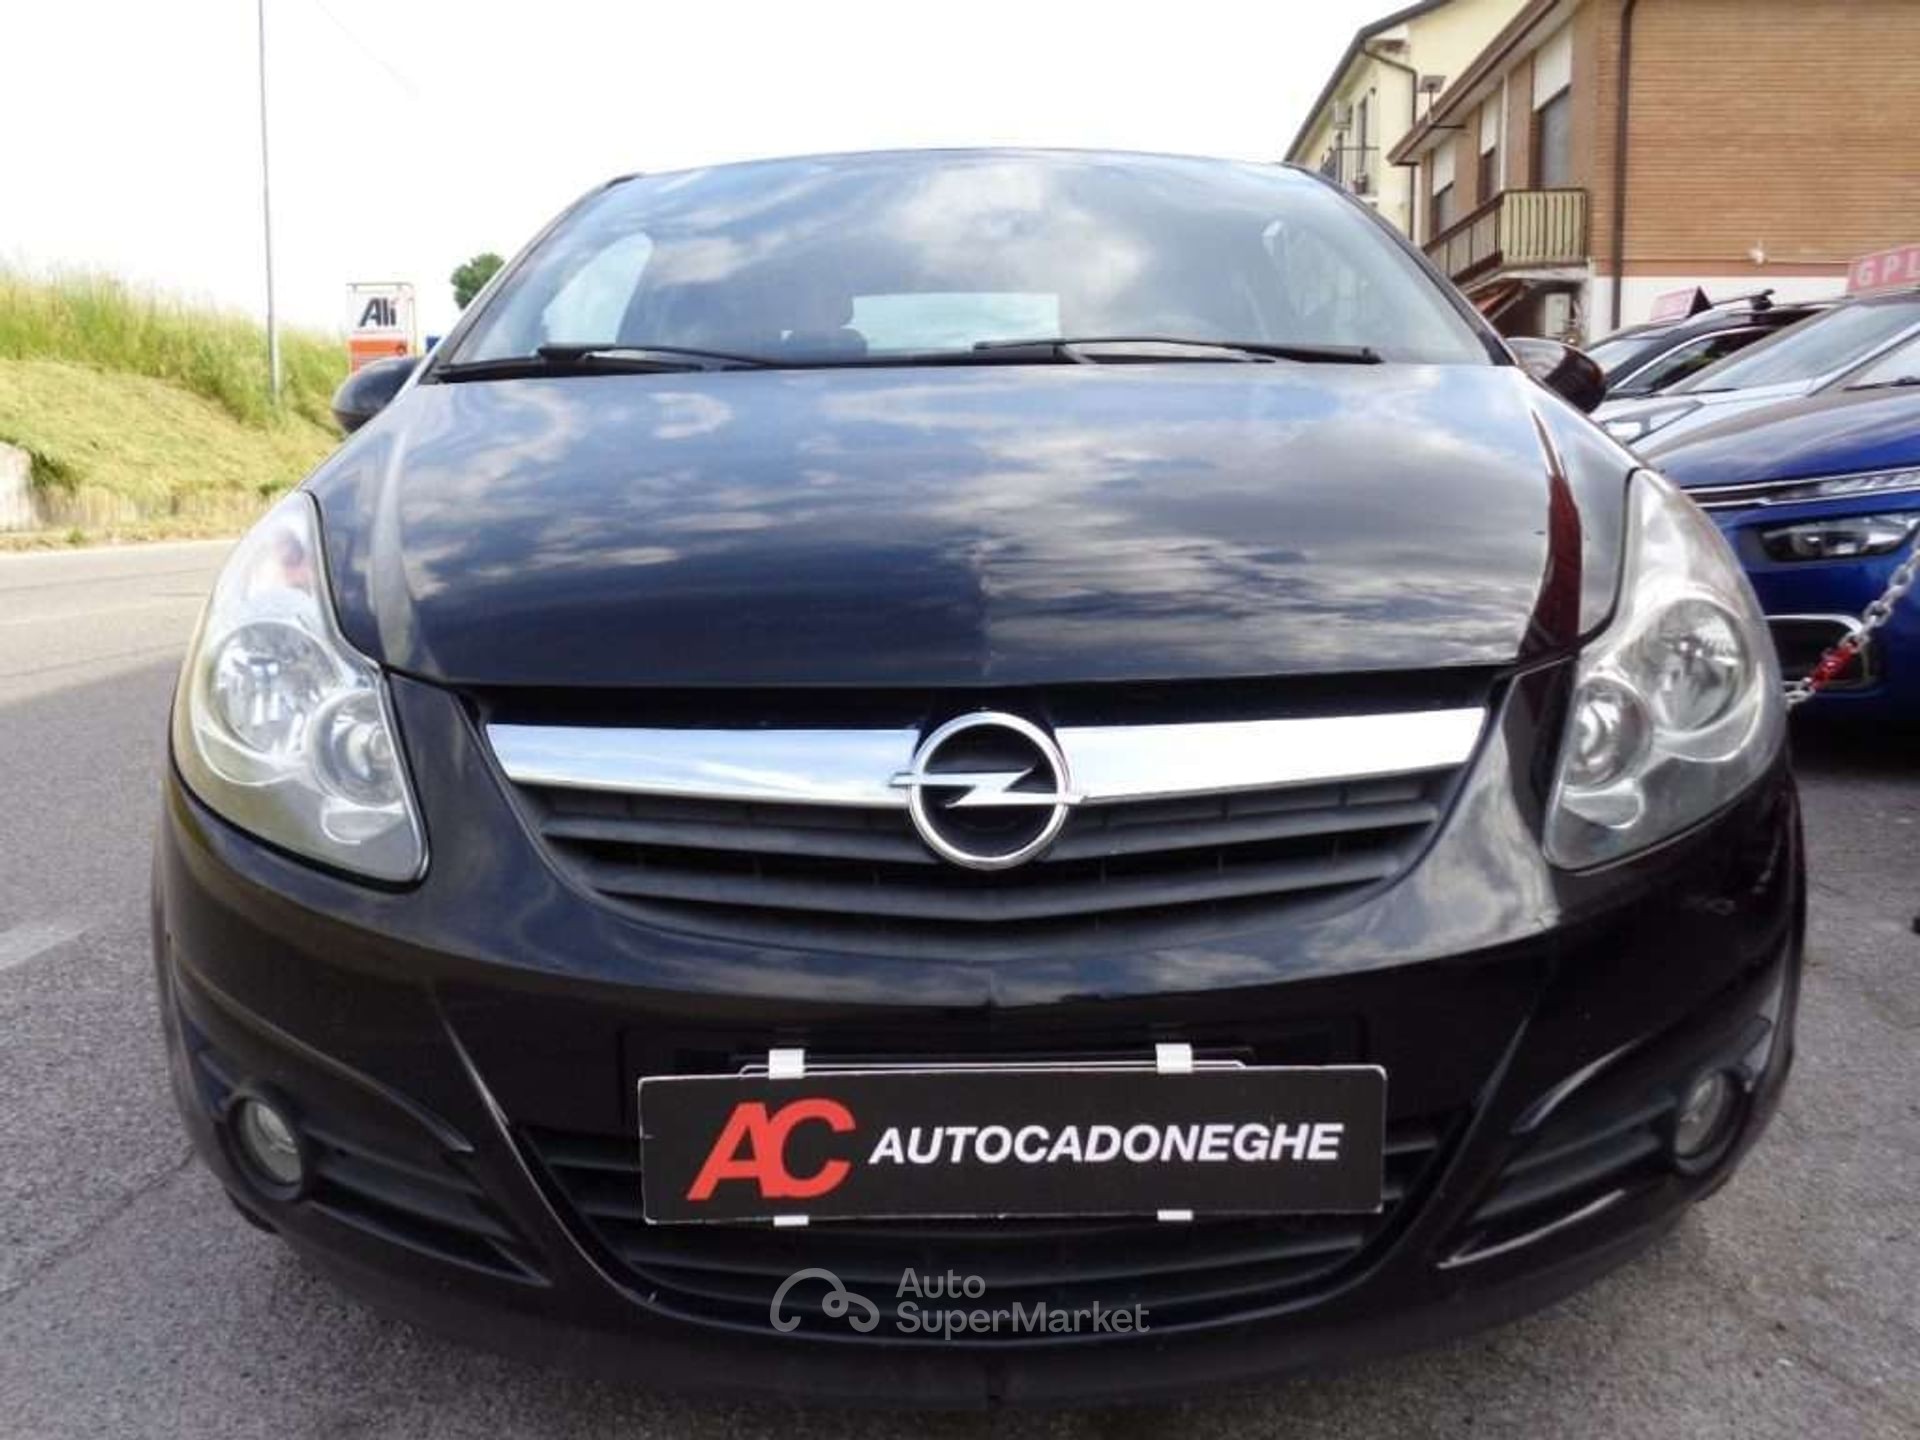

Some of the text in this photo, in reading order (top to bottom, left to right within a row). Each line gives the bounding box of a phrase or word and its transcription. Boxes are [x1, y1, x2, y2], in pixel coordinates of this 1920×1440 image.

[358, 297, 397, 327] Ali
[686, 1097, 1344, 1200] AC AUTOCADONEGHE
